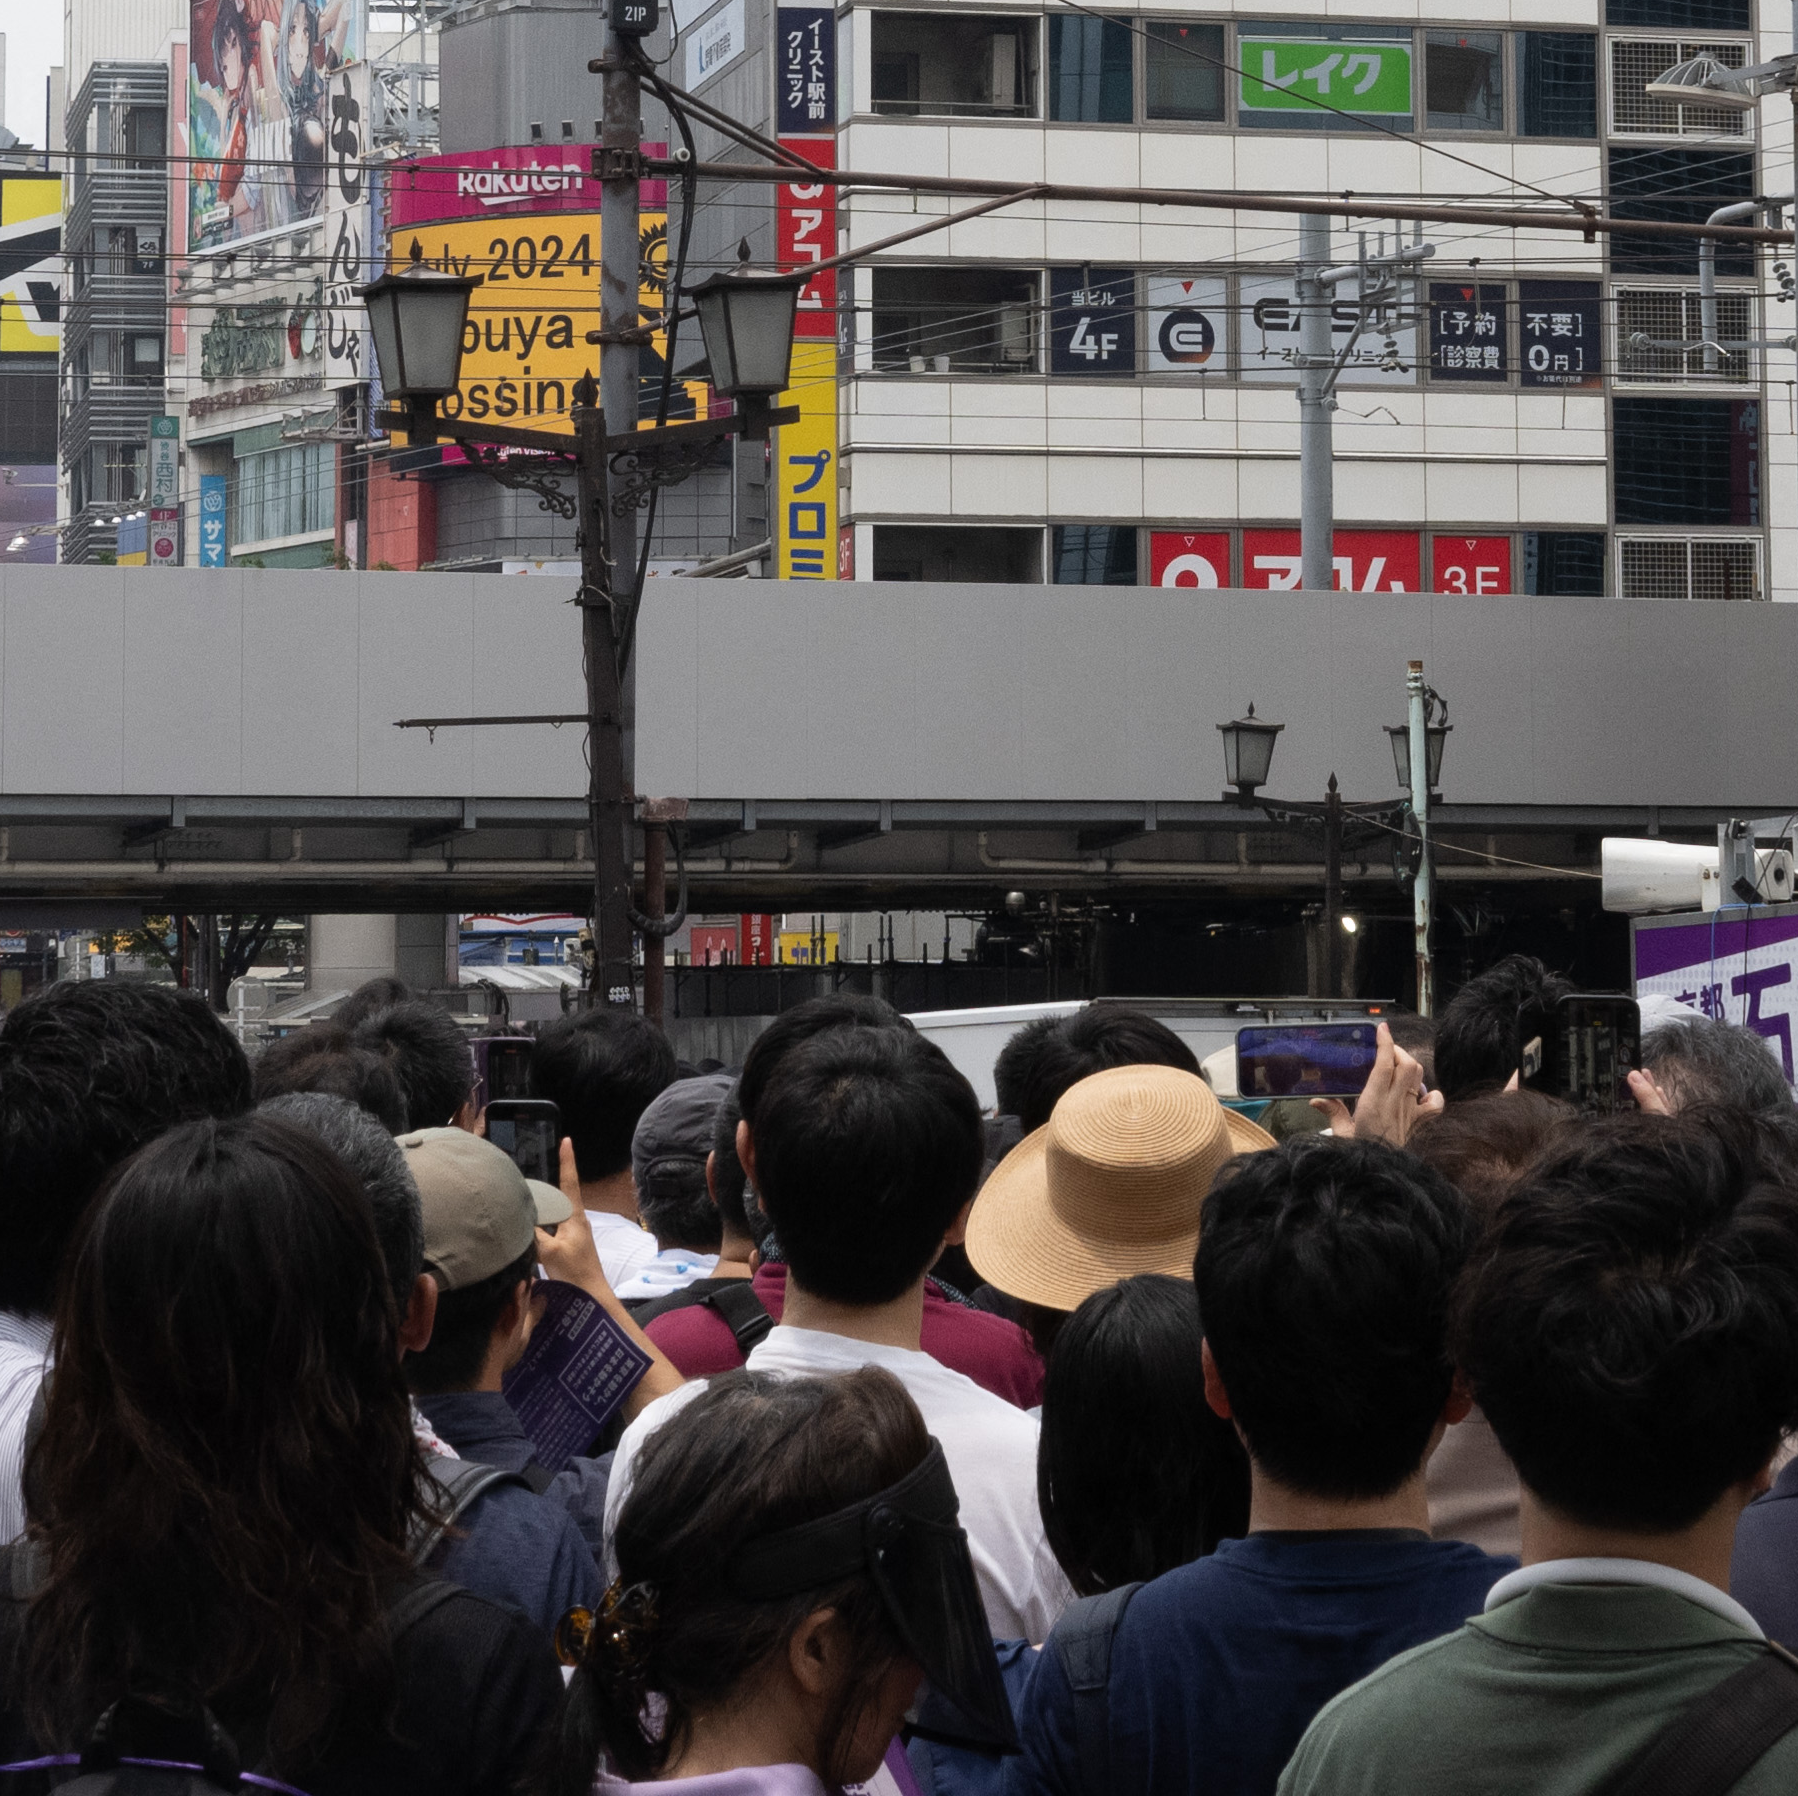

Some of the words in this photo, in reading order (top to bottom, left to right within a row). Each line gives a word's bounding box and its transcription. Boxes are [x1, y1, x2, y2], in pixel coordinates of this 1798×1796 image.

[787, 30, 803, 109] クリニック
[807, 18, 825, 120] イースト駅前
[1261, 49, 1383, 96] レイク
[457, 161, 583, 197] Rakuten
[487, 233, 594, 282] 2024
[1070, 290, 1116, 308] 当ビル
[1069, 317, 1119, 361] 4F
